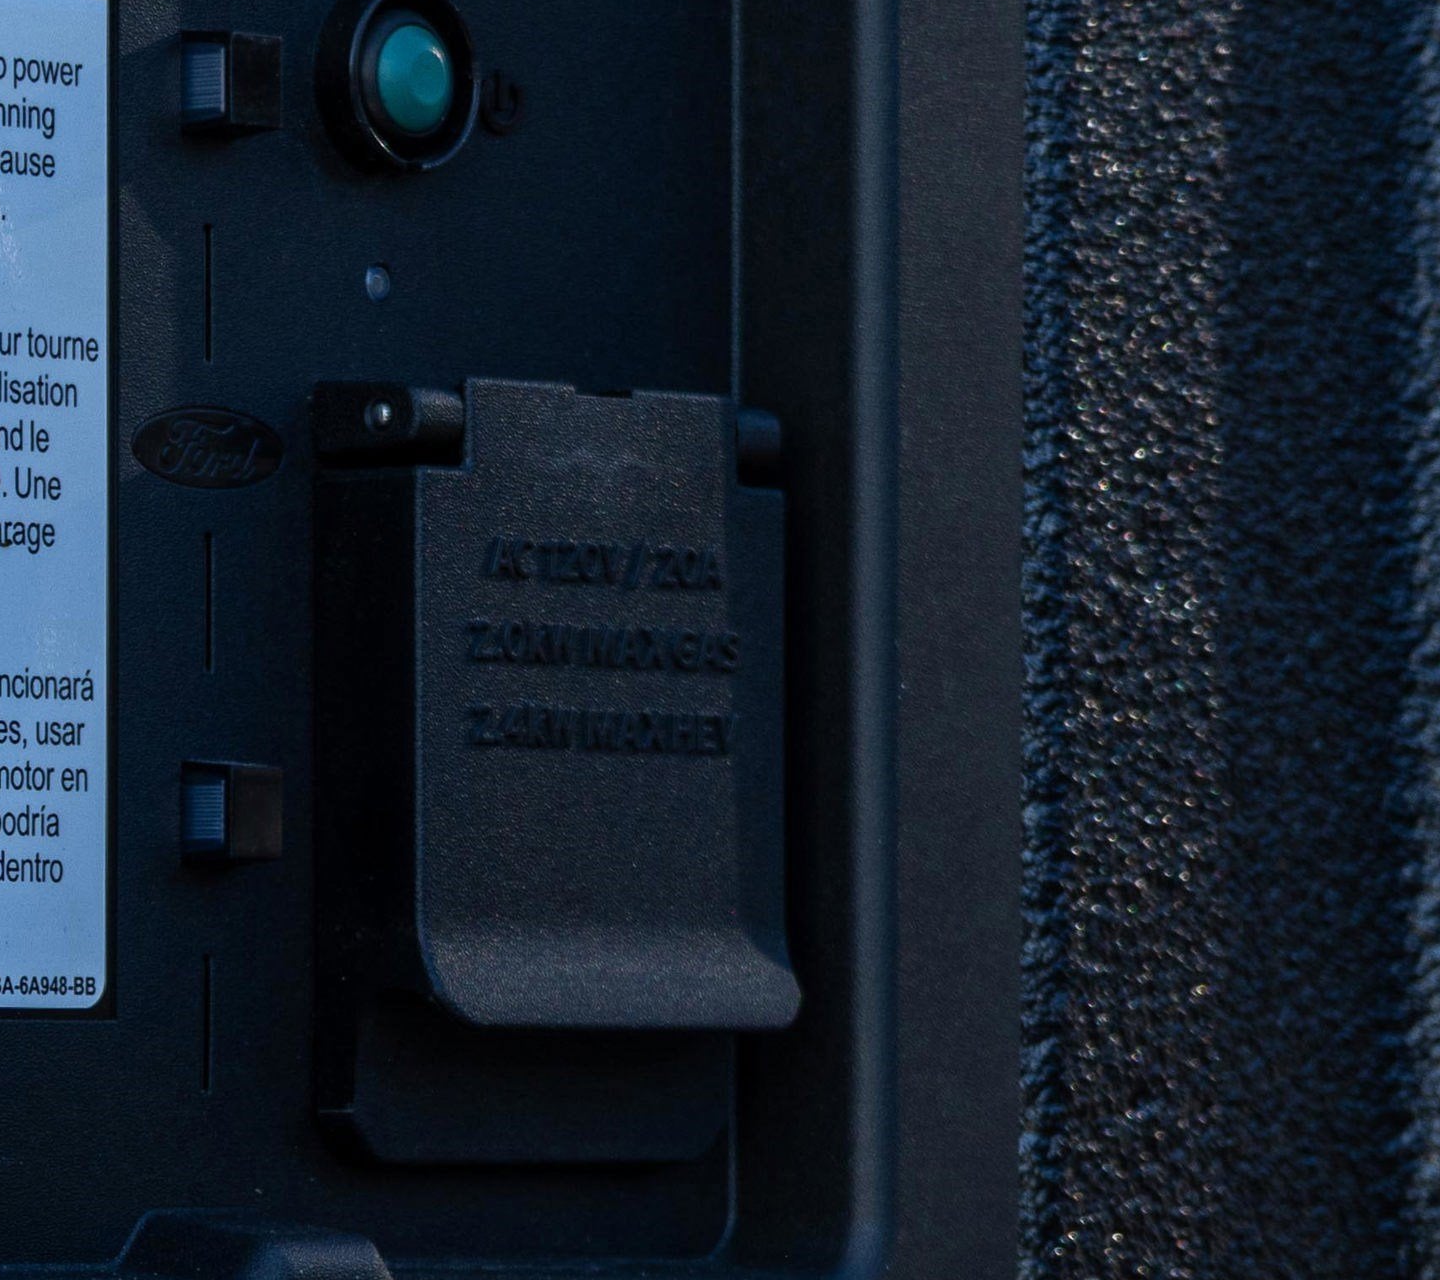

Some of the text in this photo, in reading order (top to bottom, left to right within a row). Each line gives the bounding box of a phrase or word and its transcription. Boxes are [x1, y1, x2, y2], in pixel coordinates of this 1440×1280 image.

[13, 57, 83, 90] power
[26, 327, 99, 363] tourne
[30, 420, 50, 454] le
[158, 419, 260, 479] Ford
[14, 466, 62, 501] Une
[673, 629, 741, 673] GAS
[35, 721, 86, 747] usar
[60, 767, 88, 793] en
